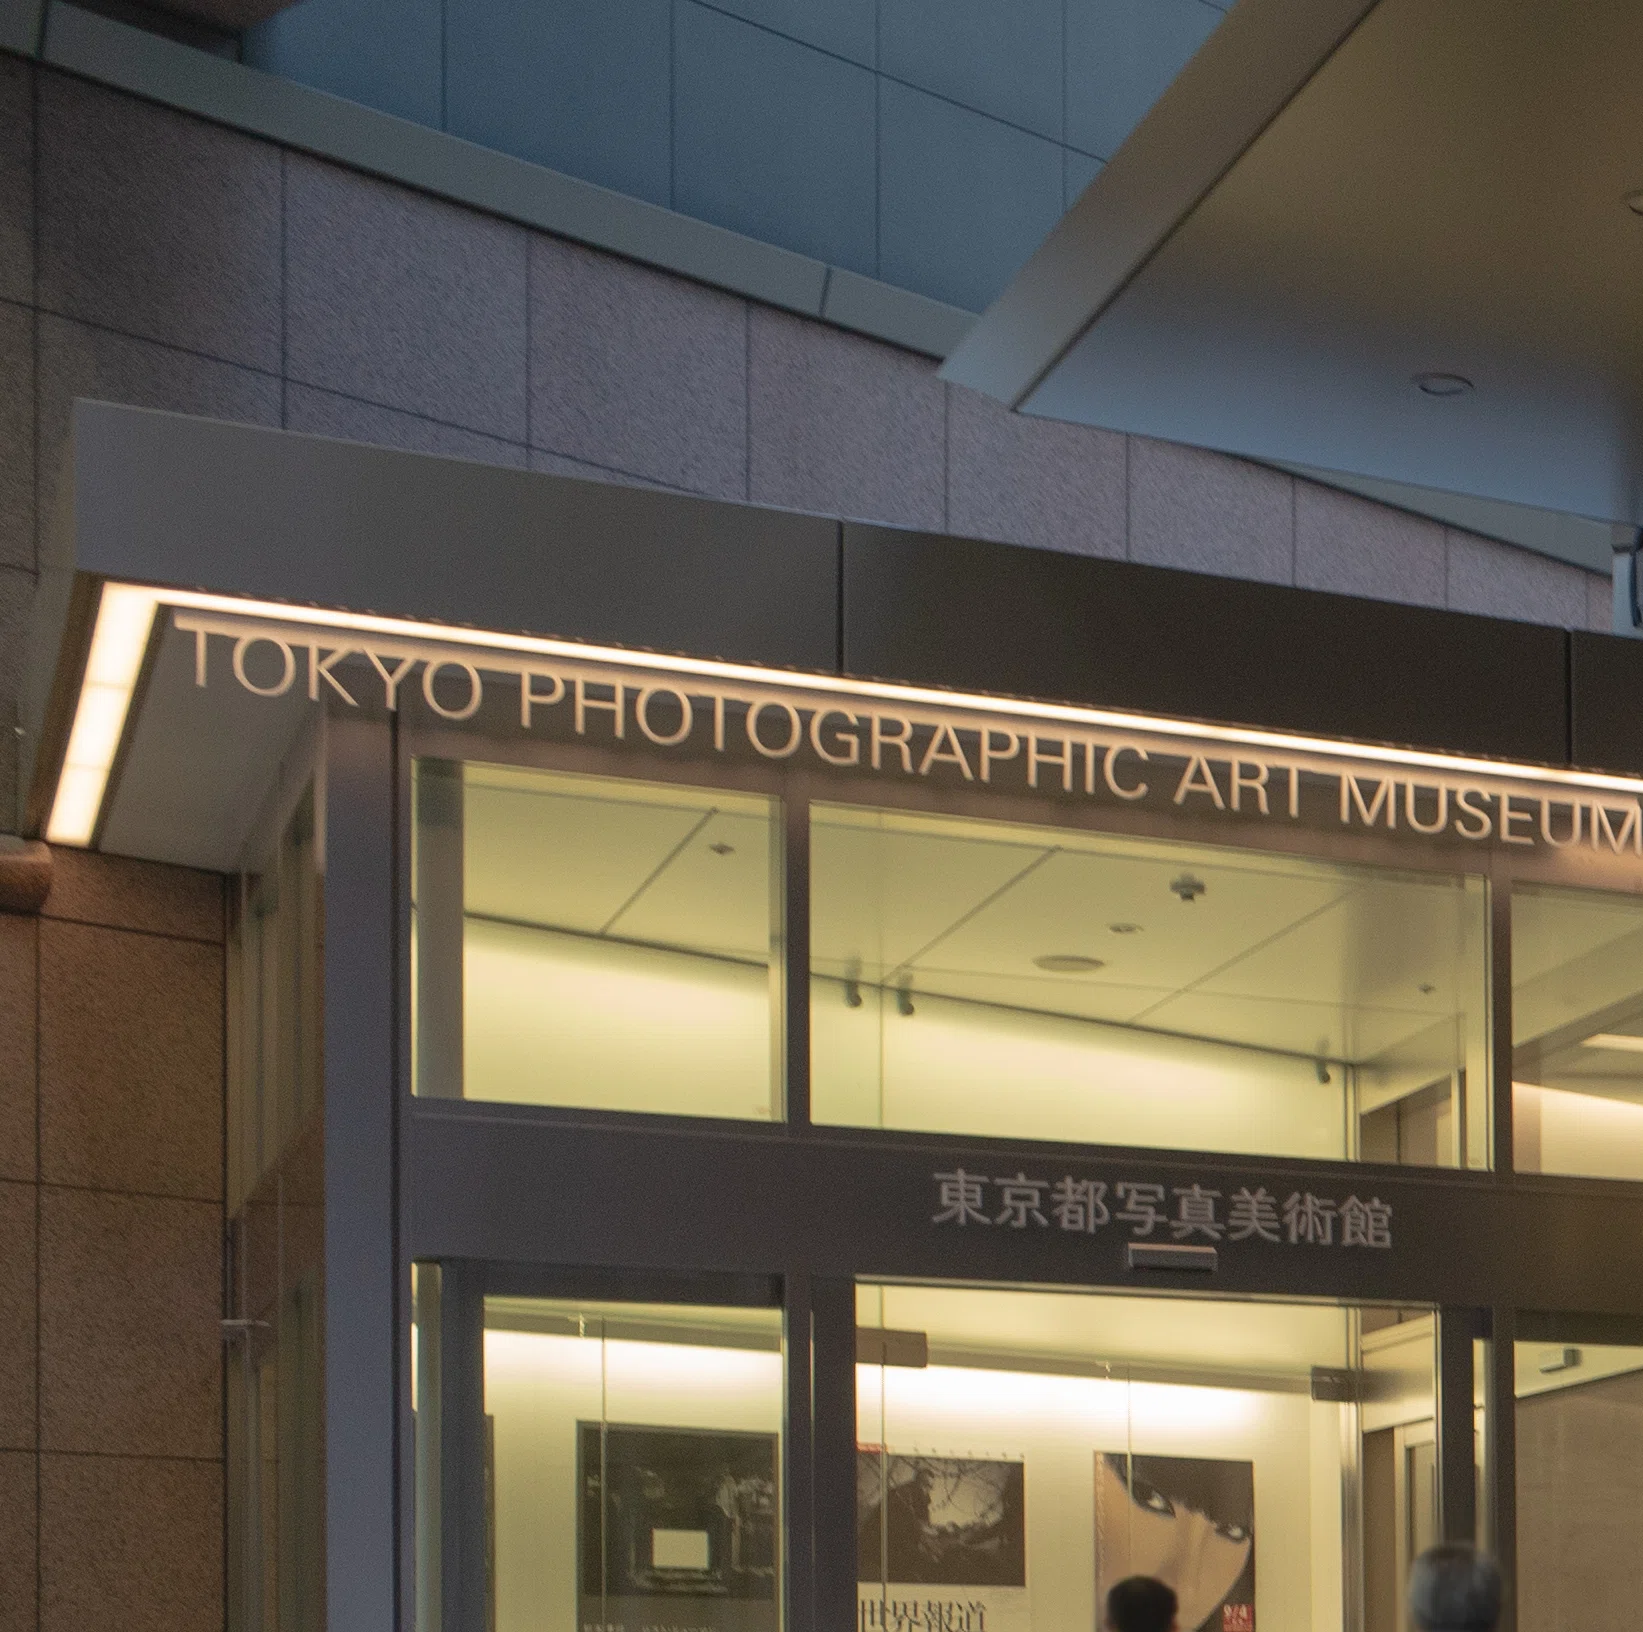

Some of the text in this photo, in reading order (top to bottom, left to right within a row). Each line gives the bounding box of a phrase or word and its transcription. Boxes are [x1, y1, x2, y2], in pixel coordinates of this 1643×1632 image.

[180, 622, 1643, 857] TOKYO PHOTOGRAPHIC ART MUSEUM
[931, 1167, 1394, 1250] 東京都写真美術館
